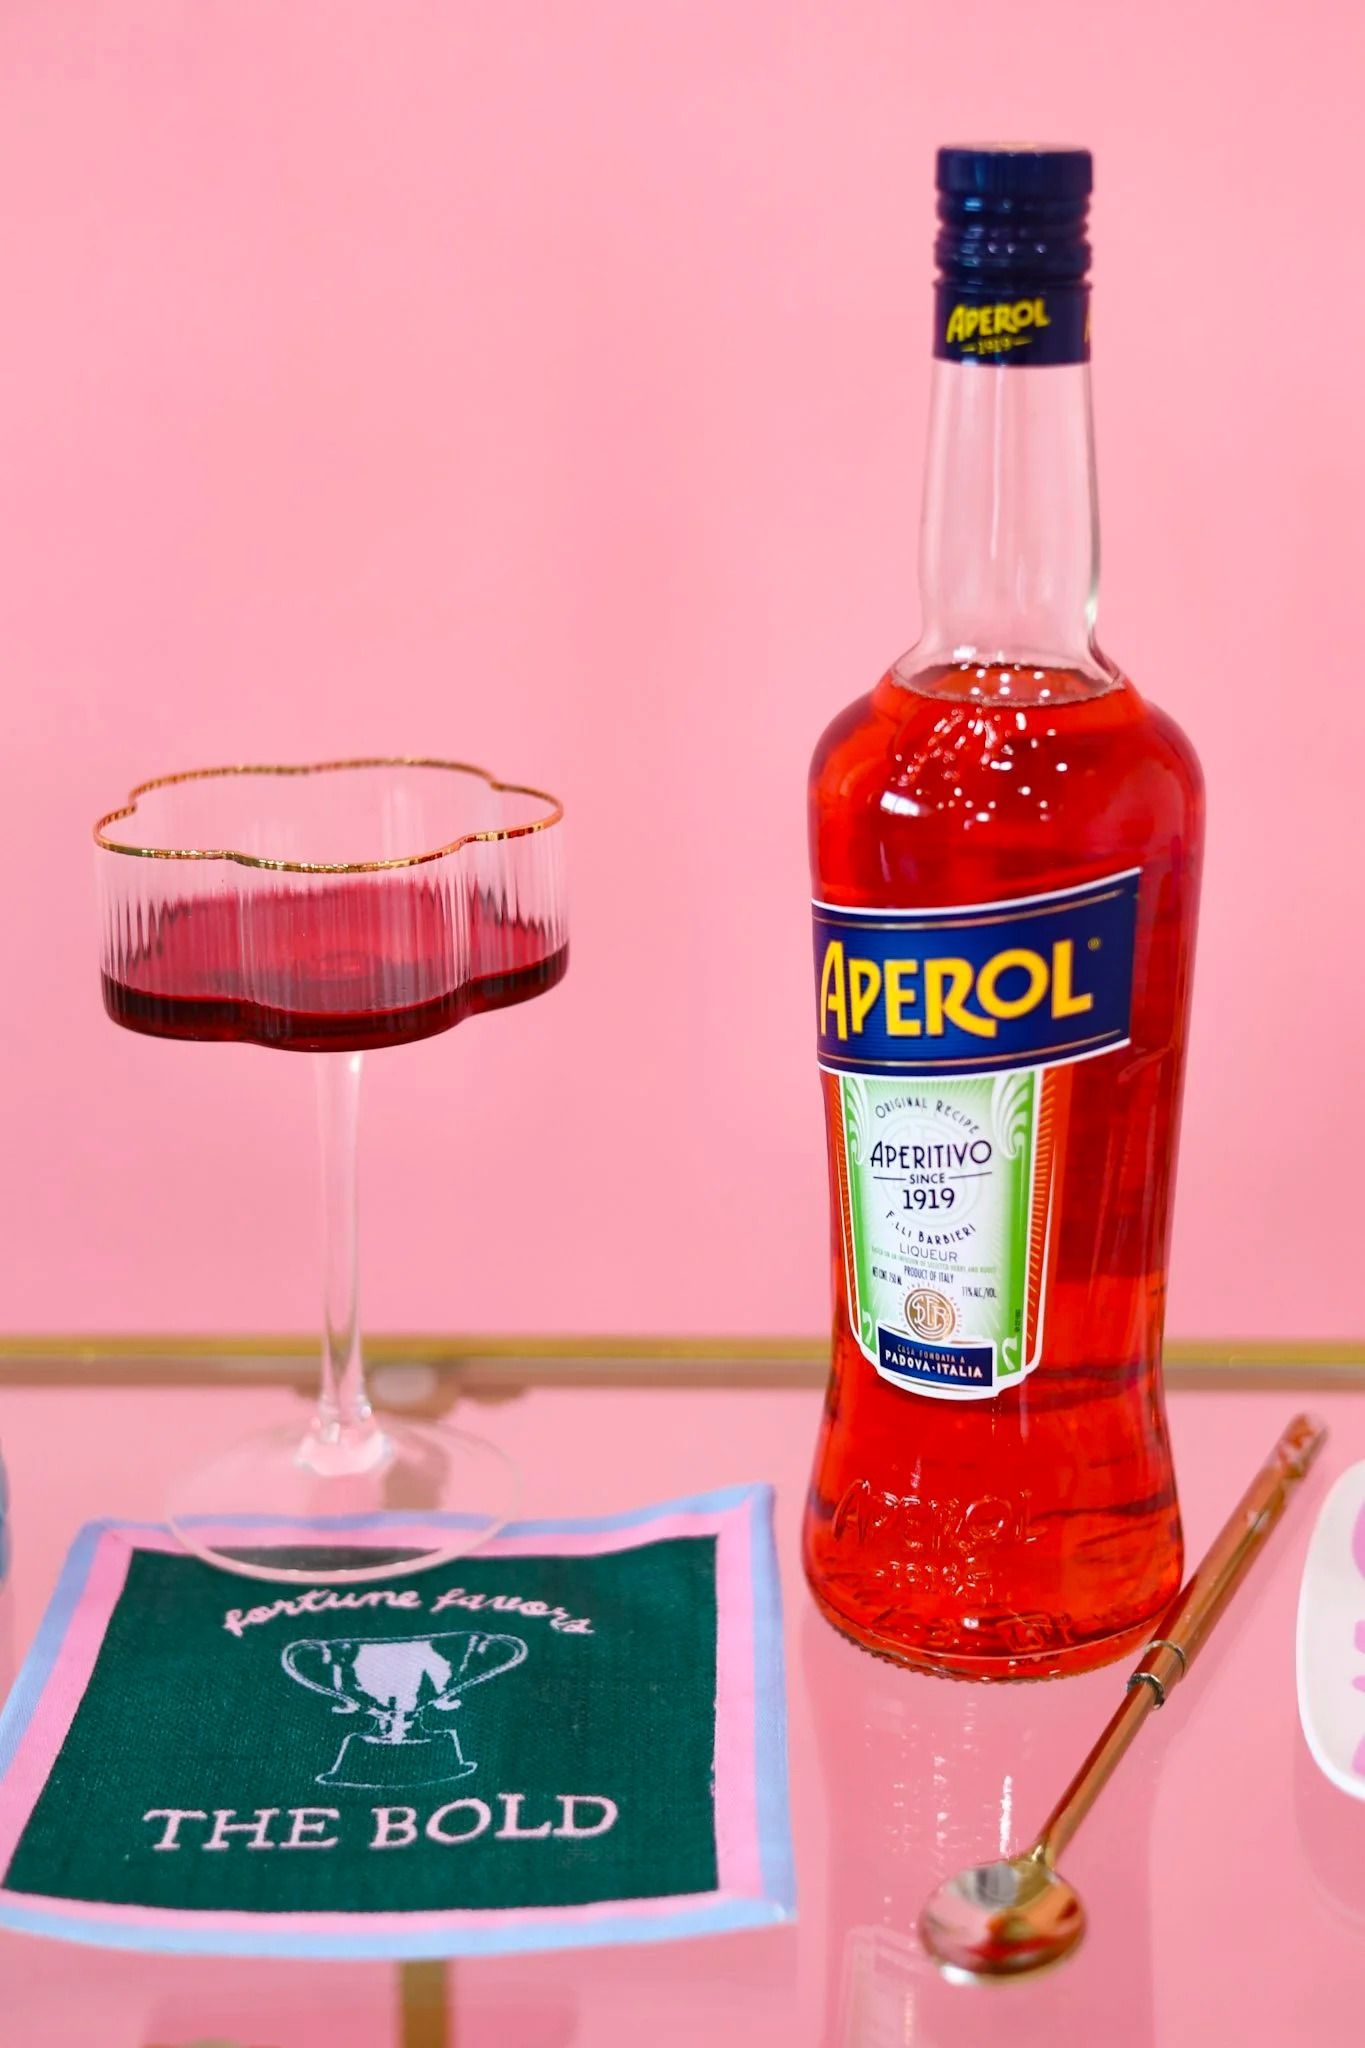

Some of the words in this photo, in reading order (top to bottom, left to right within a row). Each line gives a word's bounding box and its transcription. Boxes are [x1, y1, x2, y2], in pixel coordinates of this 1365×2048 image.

[946, 298, 1051, 343] APEROL
[820, 939, 1093, 1041] APEROL
[875, 1096, 928, 1119] ORIGINAL
[935, 1100, 980, 1134] RECIPE
[870, 1140, 992, 1169] APERITIVO
[909, 1173, 945, 1184] SINCE
[903, 1187, 955, 1210] 1919
[918, 1223, 976, 1246] BARBIERI
[899, 1242, 958, 1263] LIQUEUR
[904, 1265, 928, 1281] PRODUCT
[929, 1270, 936, 1281] OF
[938, 1272, 954, 1284] ITALY
[897, 1344, 914, 1356] CASA
[919, 1349, 956, 1363] FONDATA
[960, 1356, 966, 1364] A
[223, 1589, 422, 1637] fortune
[430, 1588, 595, 1635] favors
[143, 1807, 341, 1852] THE
[368, 1793, 620, 1850] BOLD
